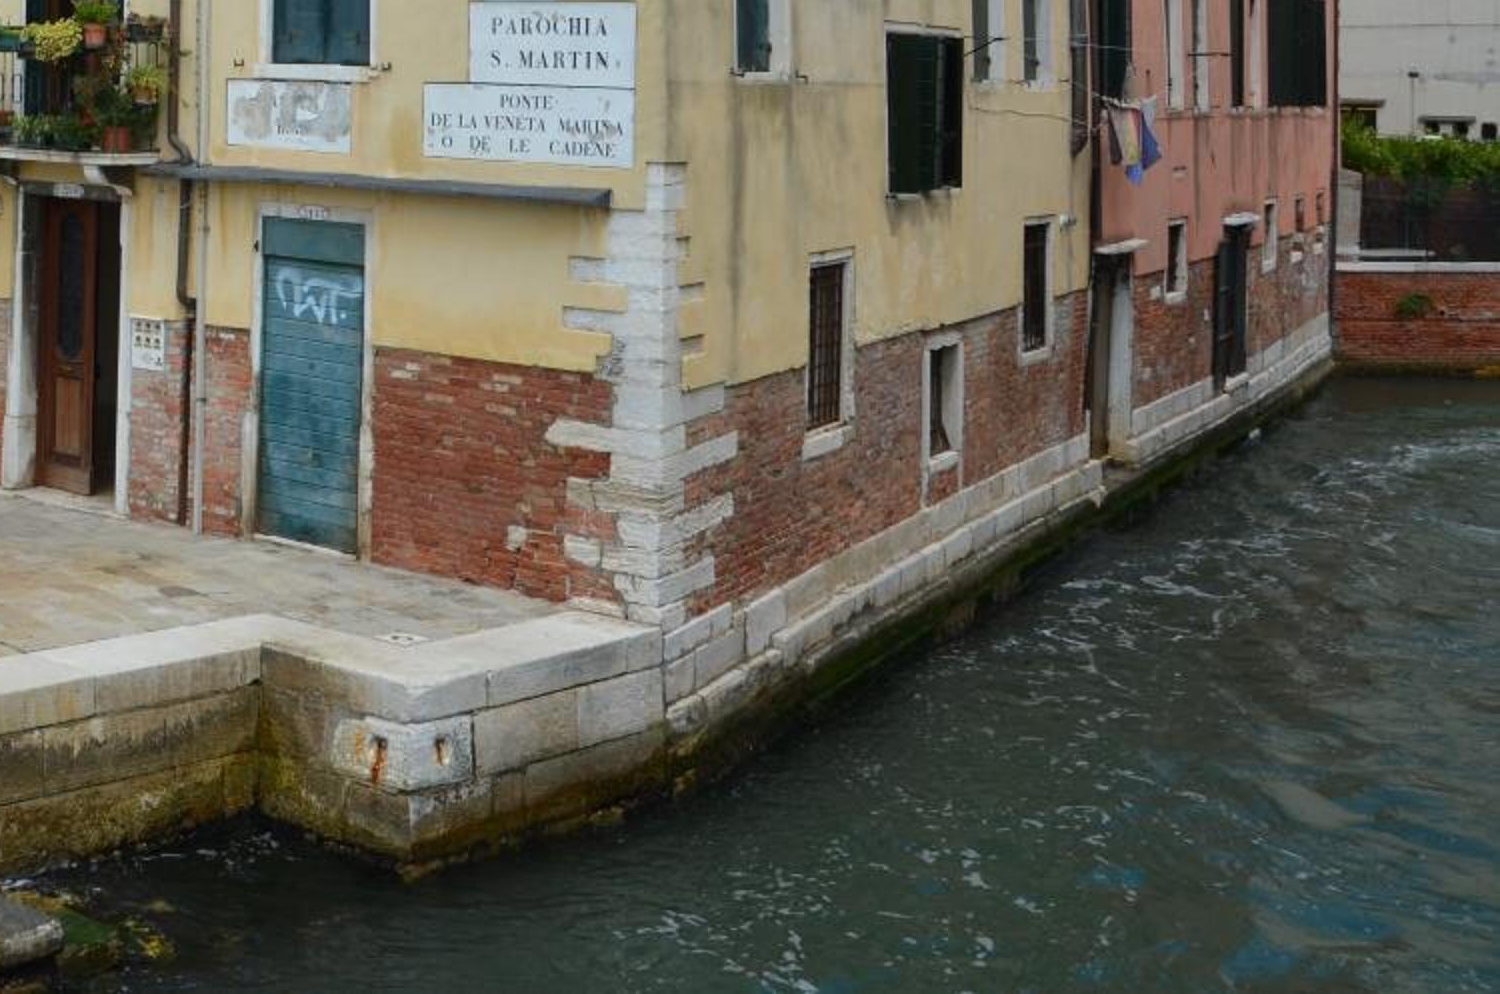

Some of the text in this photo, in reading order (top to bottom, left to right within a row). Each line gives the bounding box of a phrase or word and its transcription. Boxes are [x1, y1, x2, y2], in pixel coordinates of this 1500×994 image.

[491, 17, 608, 37] PAROCHIA
[490, 51, 510, 69] S.
[499, 93, 553, 110] PONTE
[430, 112, 624, 136] DE LA VENETA MARINA
[441, 135, 617, 158] O DE LE CADENE
